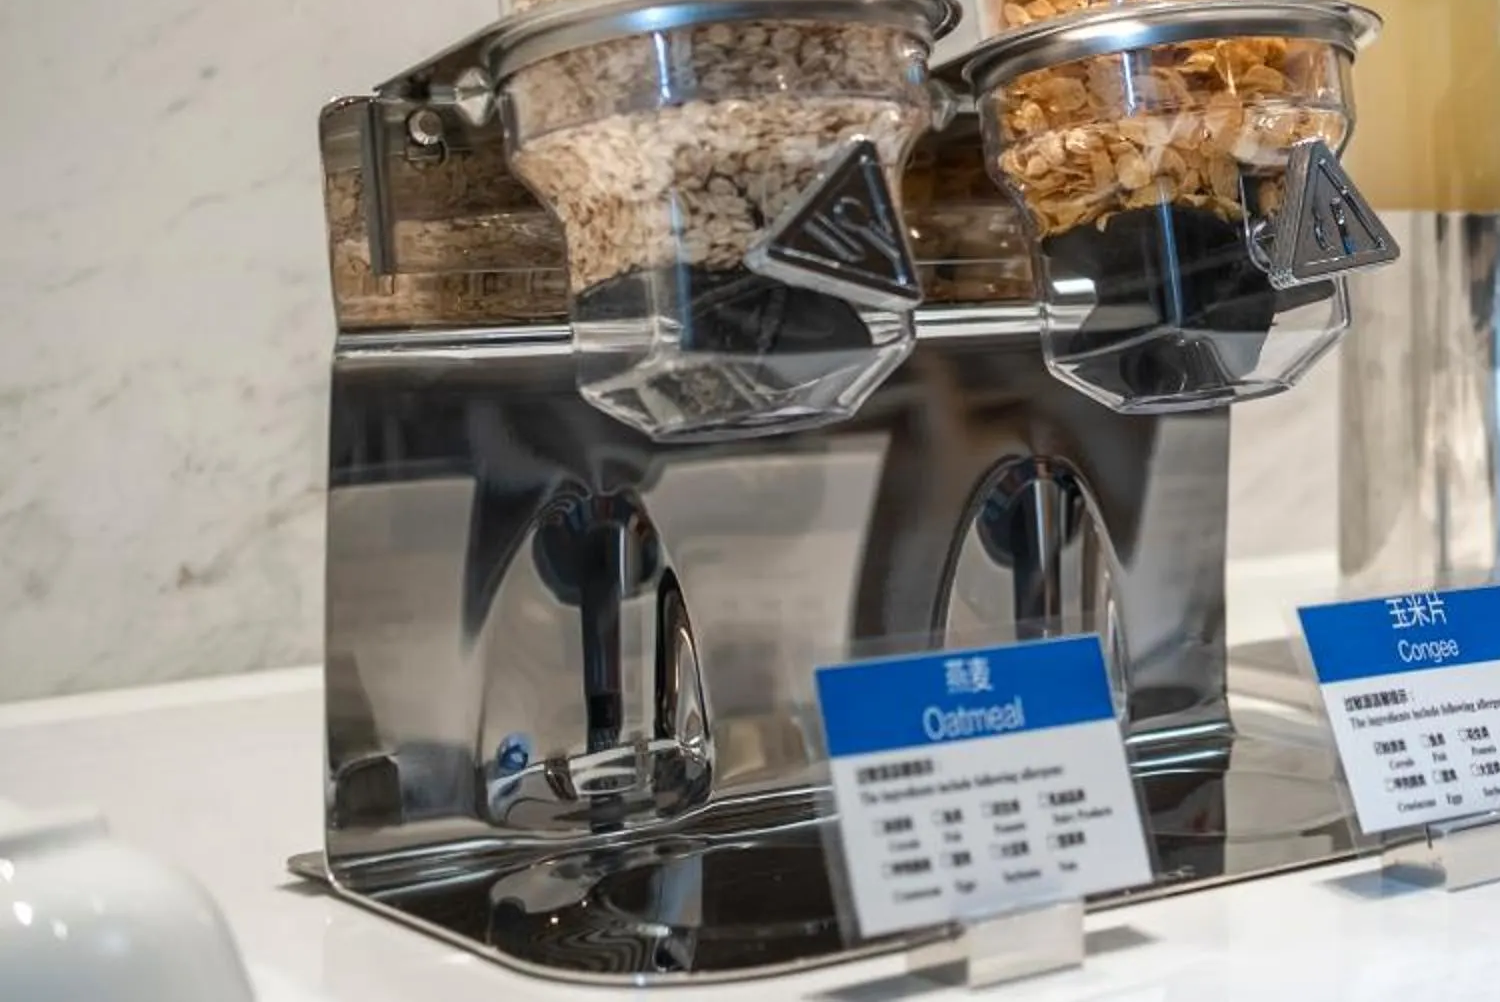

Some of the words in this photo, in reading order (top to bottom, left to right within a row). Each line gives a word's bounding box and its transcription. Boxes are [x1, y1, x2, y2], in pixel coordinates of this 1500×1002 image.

[1385, 590, 1448, 629] 玉米片
[1397, 638, 1460, 663] Congee
[922, 696, 1024, 740] Oatmeal
